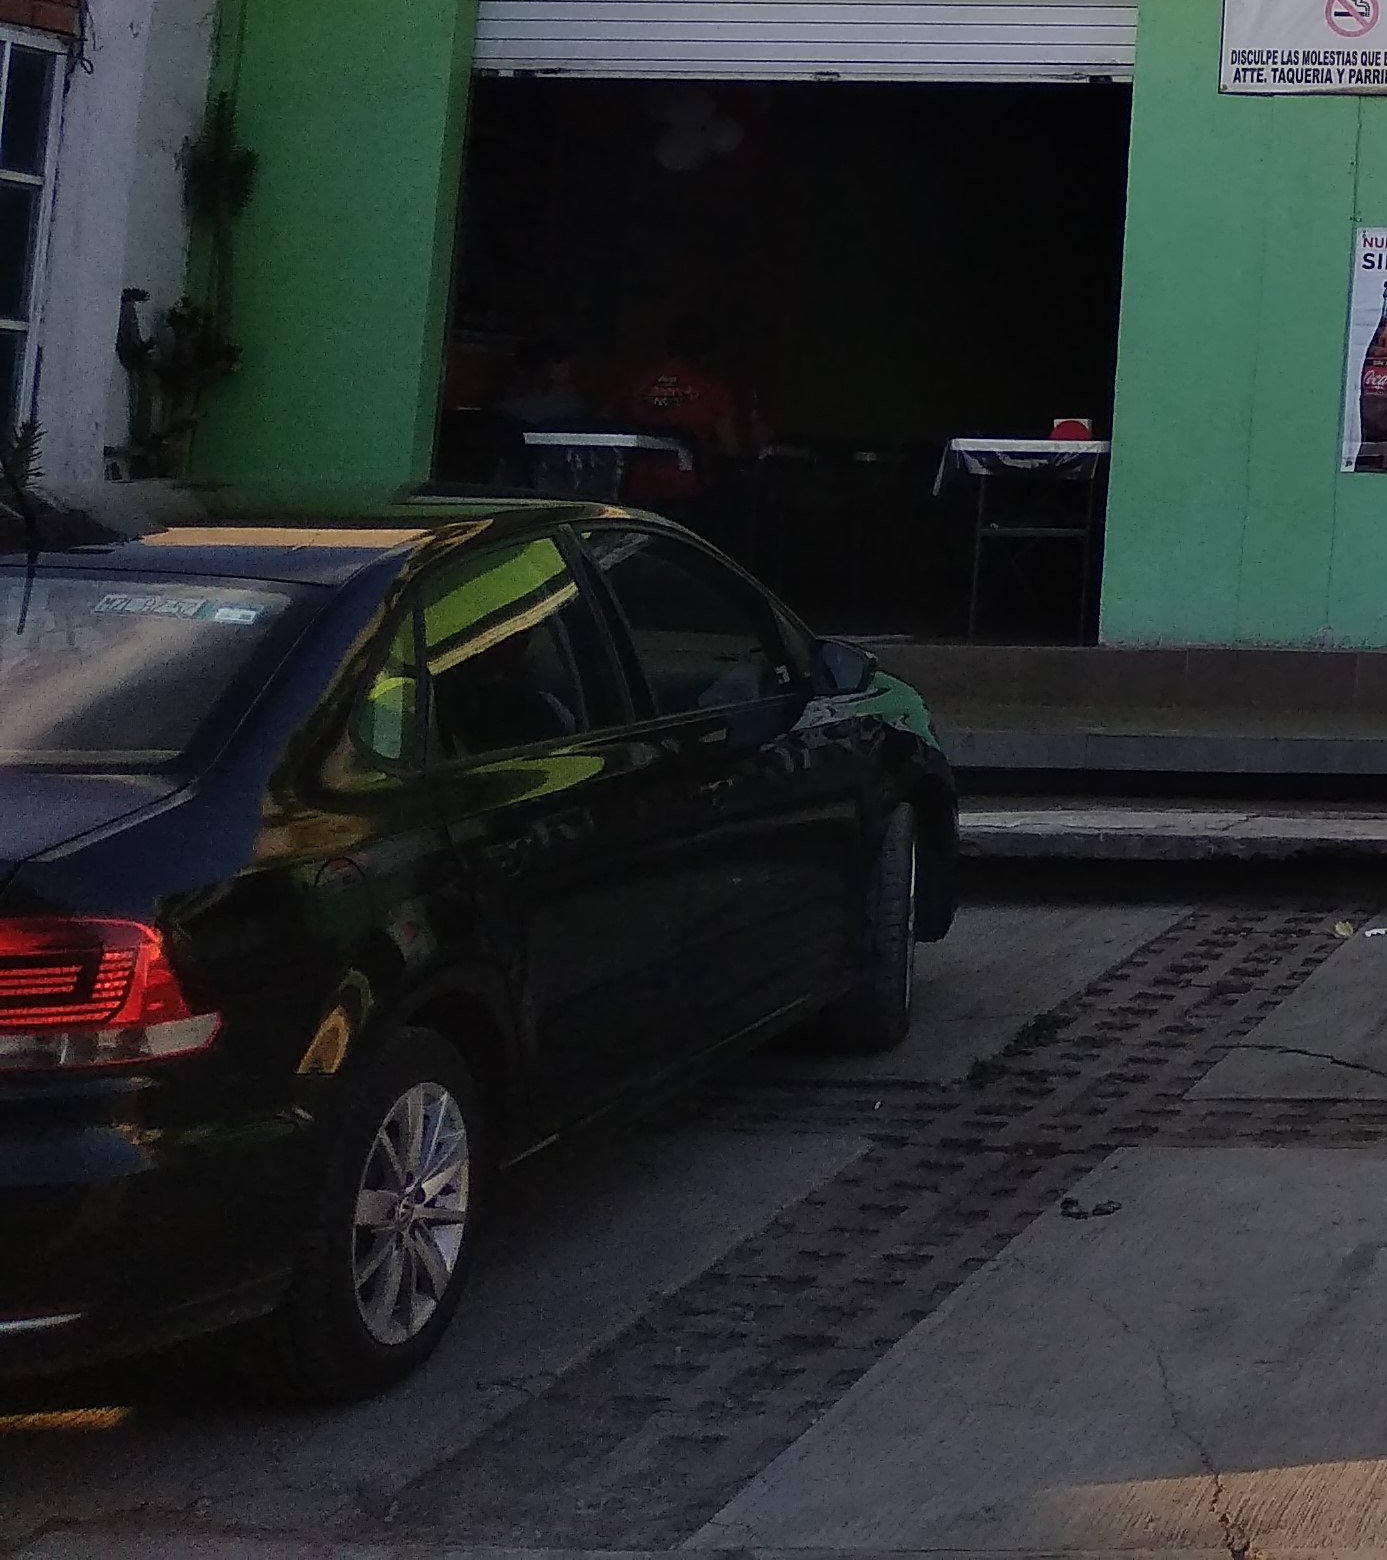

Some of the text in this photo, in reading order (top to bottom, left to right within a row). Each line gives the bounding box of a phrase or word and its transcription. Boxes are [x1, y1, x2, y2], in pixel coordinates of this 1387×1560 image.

[1231, 49, 1279, 66] DISCULPE
[1280, 50, 1300, 66] LAS
[1302, 50, 1358, 67] MOLESTIAS
[1360, 51, 1381, 68] QUE
[1233, 67, 1268, 84] ATTE.
[1271, 68, 1333, 85] TAQUERIA
[1336, 68, 1345, 84] Y
